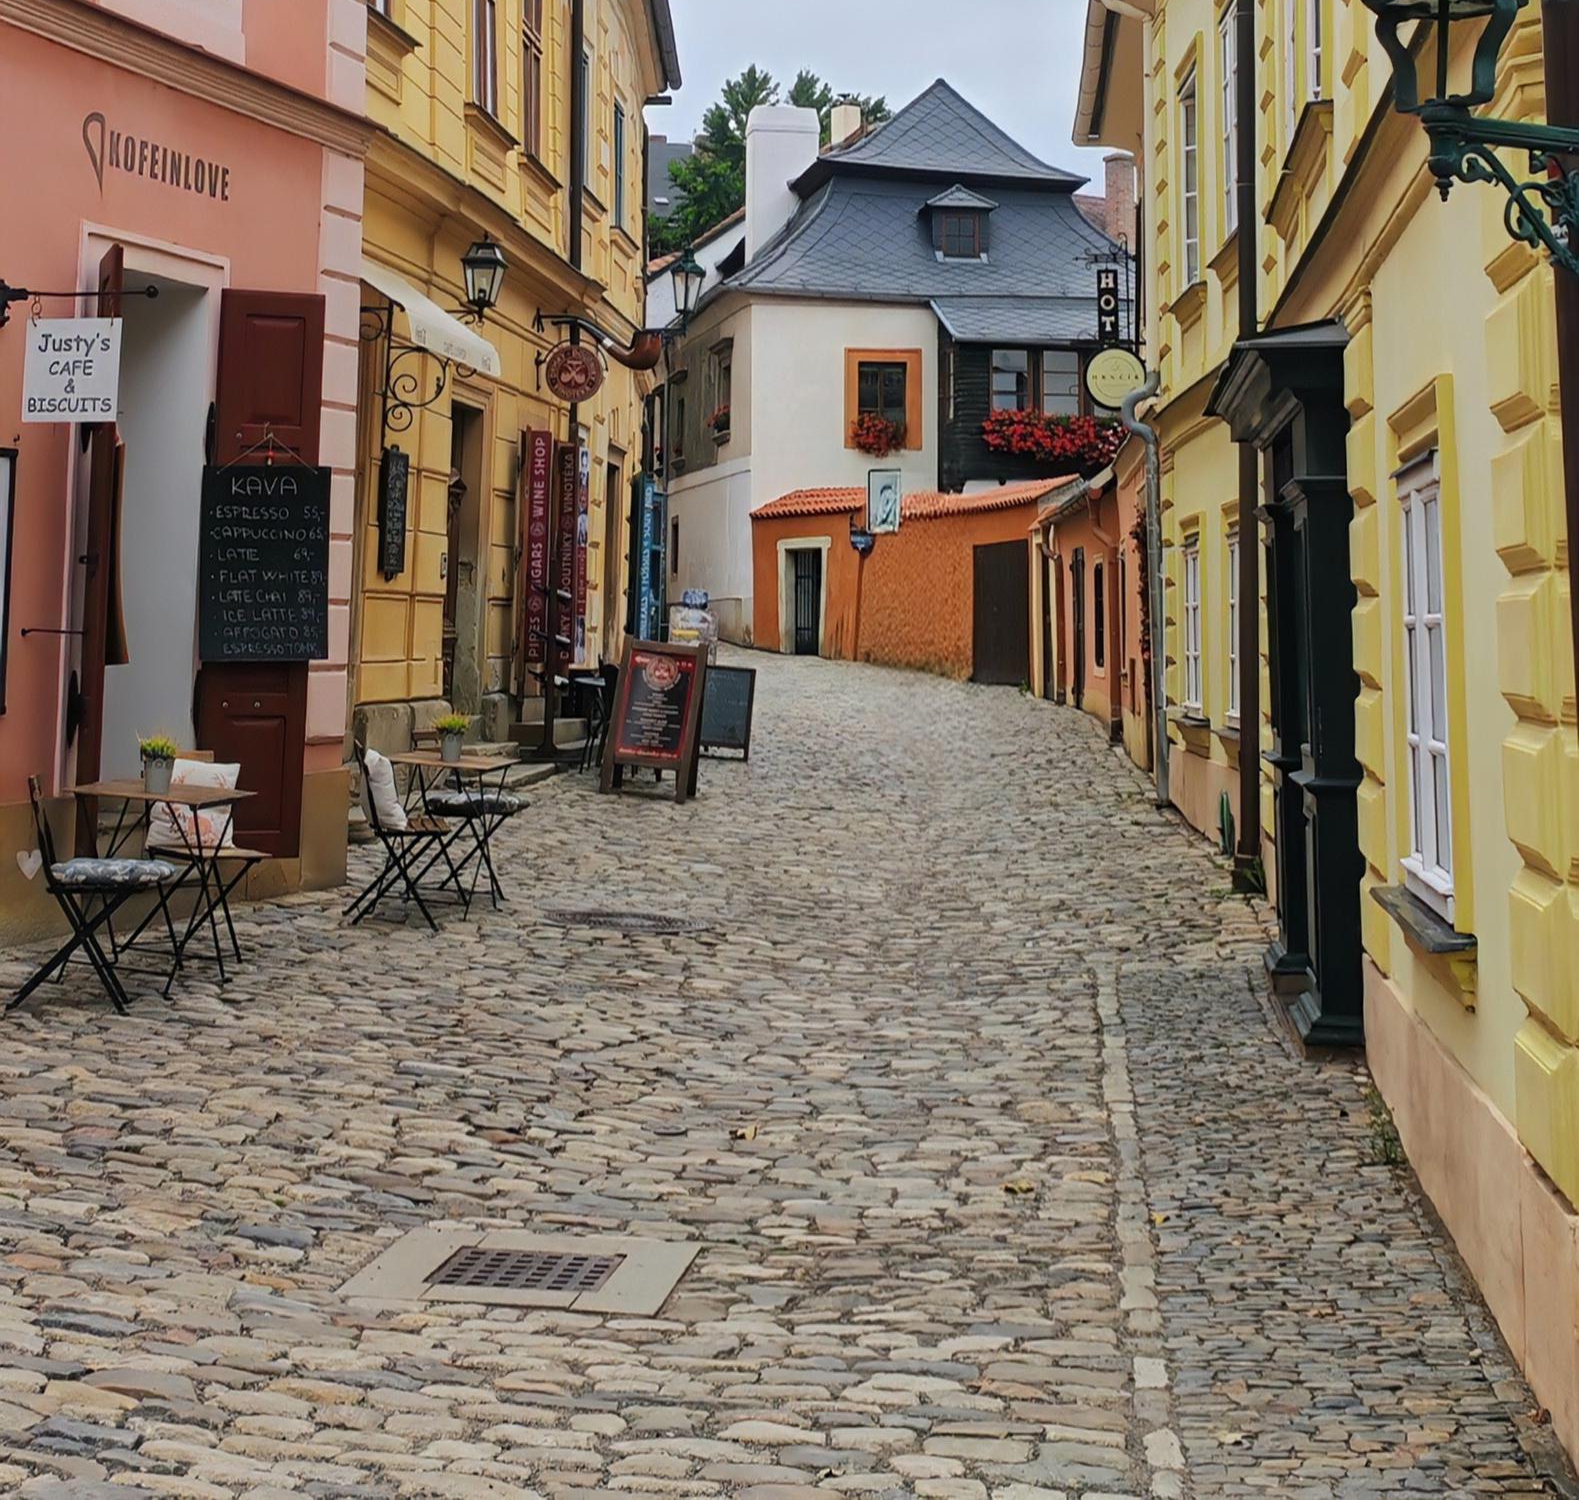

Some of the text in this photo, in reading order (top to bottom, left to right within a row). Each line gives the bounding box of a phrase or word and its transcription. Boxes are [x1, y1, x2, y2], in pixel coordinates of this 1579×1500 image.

[109, 130, 230, 201] KOFEINLOVE
[38, 333, 111, 357] Justy's
[49, 360, 94, 376] CAFE
[64, 378, 75, 394] &
[28, 397, 112, 413] BISCUITS
[534, 437, 546, 475] SHOP
[533, 481, 545, 518] WINE
[216, 505, 289, 520] ESPRESSO
[213, 525, 307, 541] CAPPUCCINO
[220, 569, 257, 583] FLAT
[262, 571, 309, 583] WHITE
[256, 589, 287, 602] CHAI
[224, 609, 246, 622] ICE
[253, 608, 298, 622] LATTE
